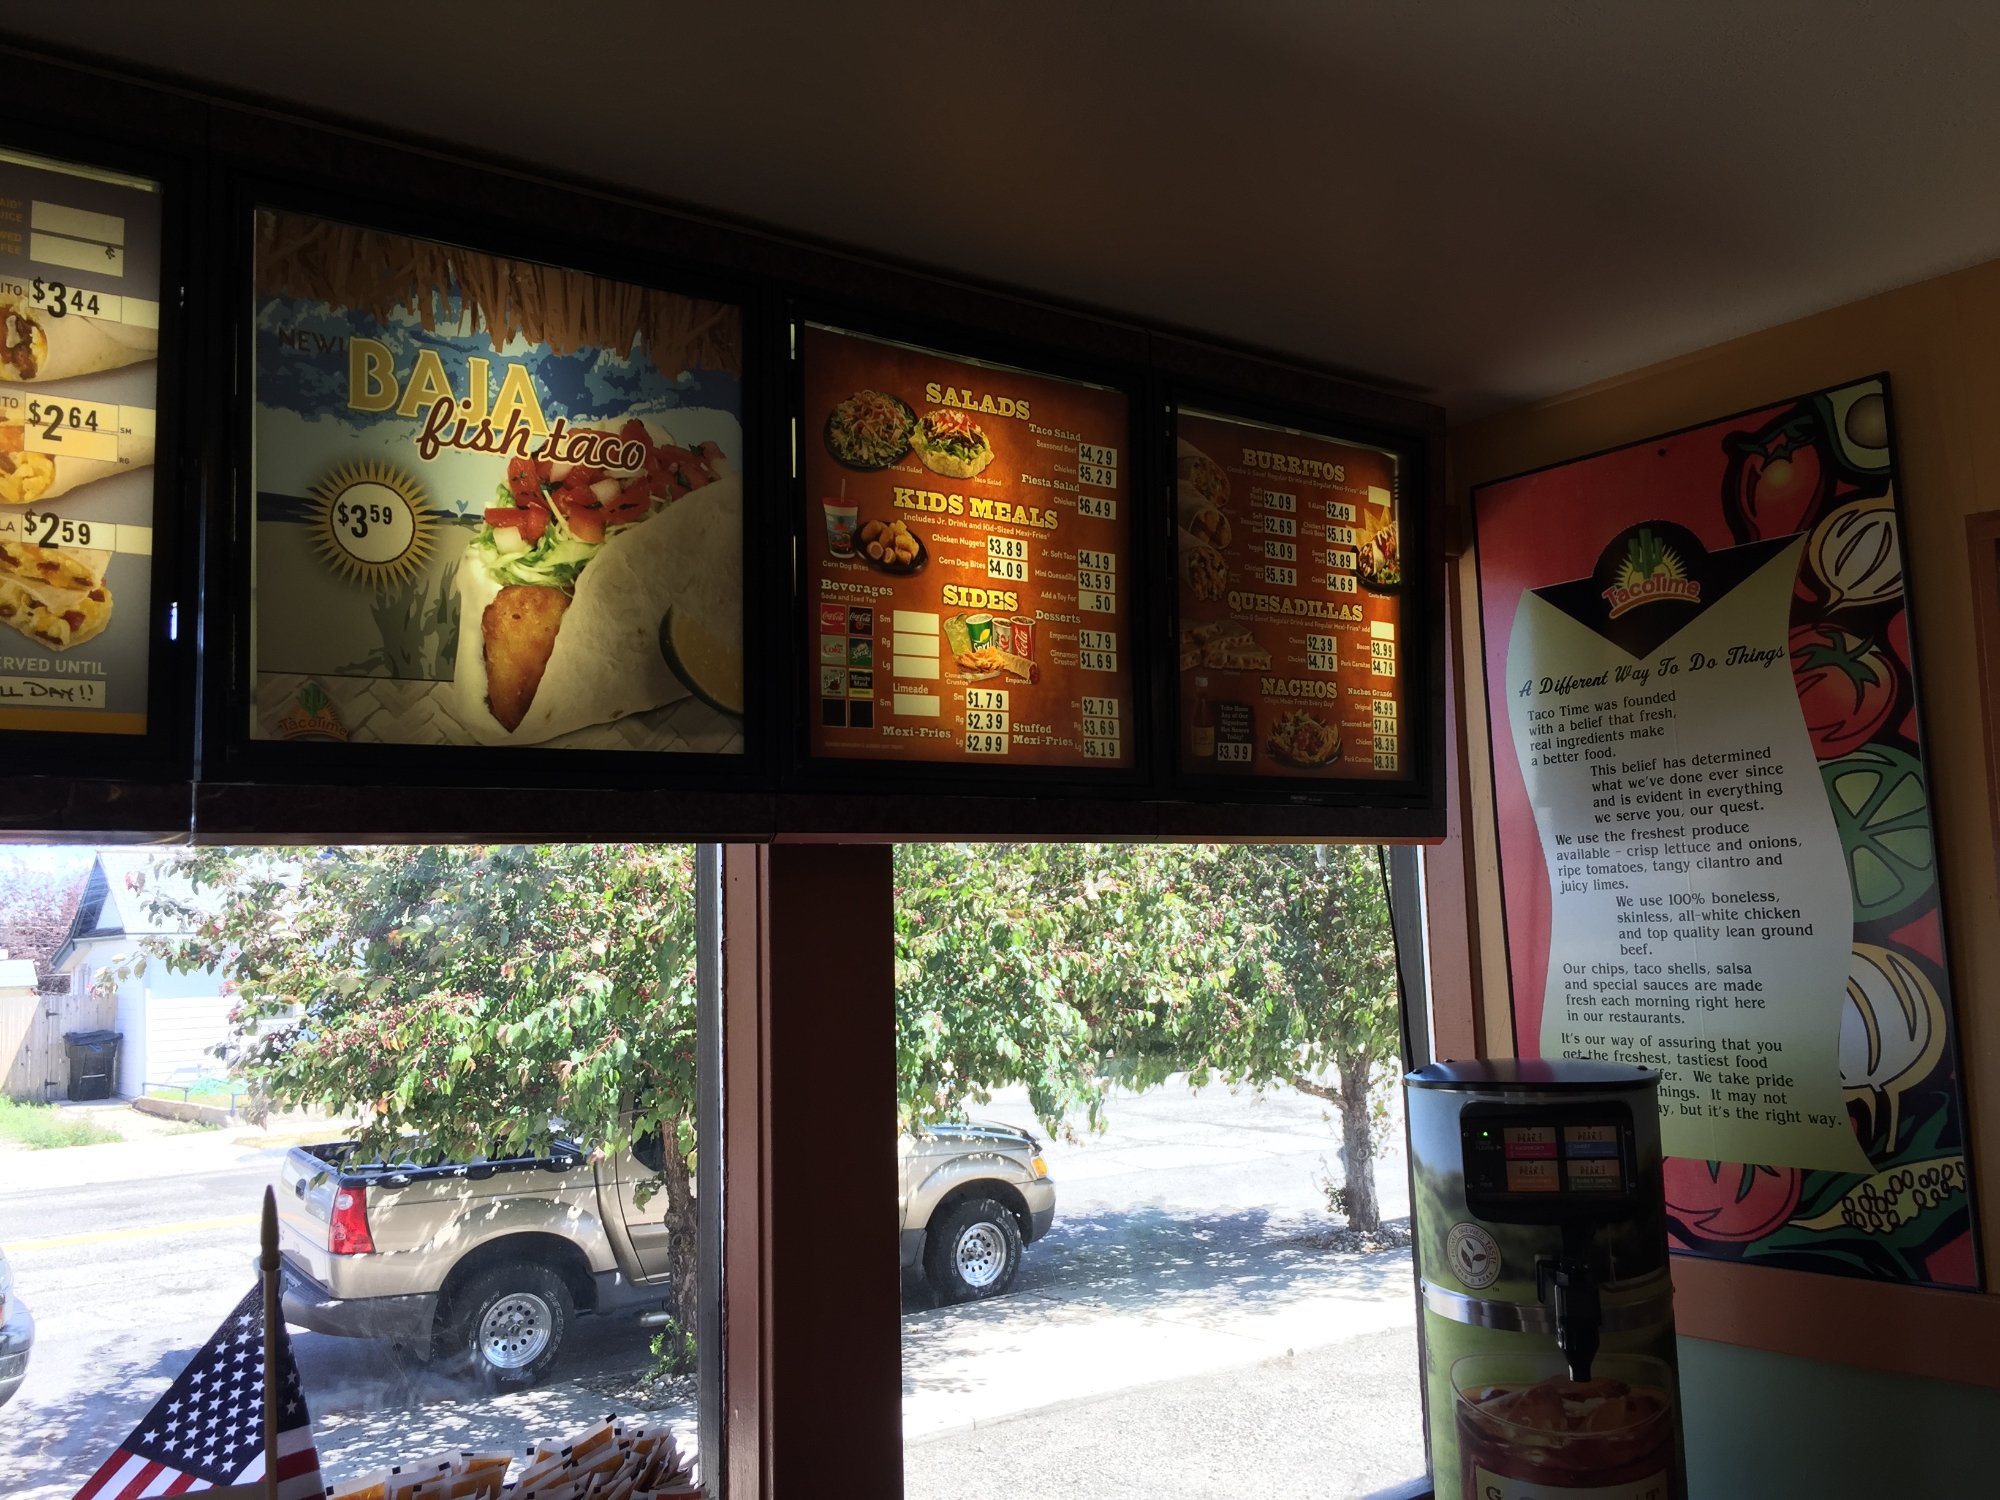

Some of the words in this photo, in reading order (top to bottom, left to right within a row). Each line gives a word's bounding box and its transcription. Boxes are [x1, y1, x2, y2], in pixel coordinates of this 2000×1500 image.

[278, 329, 347, 353] NEW!
[347, 336, 550, 438] BAJA
[925, 382, 1031, 420] SALADS
[416, 395, 530, 461] fish
[540, 418, 647, 472] taco
[1029, 423, 1053, 436] Taco
[1054, 428, 1081, 441] Salad
[1080, 445, 1112, 465] $4.29
[1054, 465, 1076, 474] Chicken
[1242, 448, 1345, 482] BURRITOS
[1021, 475, 1051, 487] Fiesta
[1053, 480, 1080, 492] Salad
[1079, 466, 1112, 485] $5.29
[894, 487, 964, 515] KIDS
[969, 497, 1058, 530] MEALS
[1054, 496, 1076, 506] Chicken
[1080, 498, 1110, 517] $6.49
[1264, 492, 1291, 509] $2.09
[1328, 502, 1350, 520] $2.49
[903, 513, 935, 524] Includes
[937, 517, 947, 526] Jr.
[948, 518, 968, 528] Drink
[969, 521, 982, 529] and
[983, 523, 1014, 534] Kid-Sized
[1266, 518, 1292, 534] $2.69
[932, 534, 958, 544] Chicken
[959, 537, 985, 548] Nuggets
[1328, 527, 1352, 543] $5.19
[989, 538, 1022, 557] $3.89
[1051, 550, 1063, 559] Soft
[1267, 542, 1292, 559] $3.09
[840, 562, 852, 571] Dog
[939, 557, 955, 565] Corn
[956, 559, 969, 569] Dog
[970, 561, 985, 569] Bites
[1079, 551, 1109, 570] $4.19
[1328, 552, 1351, 568] $3.89
[990, 560, 1022, 579] $4.09
[1035, 569, 1047, 577] Mini
[1048, 571, 1076, 581] Quesadilla
[1267, 568, 1292, 584] $5.59
[821, 579, 893, 597] Beverages
[1080, 572, 1110, 589] $3.59
[1328, 576, 1353, 592] $4.69
[943, 584, 1018, 612] SIDES
[1602, 573, 1700, 606] TacoTime
[1090, 596, 1110, 610] .50
[1227, 591, 1363, 622] QUESADILLAS
[880, 615, 891, 623] Sm
[1036, 610, 1080, 624] Desserts
[882, 638, 890, 647] Rg
[1050, 631, 1077, 641] Empanada
[1081, 632, 1110, 648] $1.79
[1308, 636, 1332, 651] $2.39
[1372, 642, 1392, 657] $3.99
[56, 660, 107, 675] UNTIL
[883, 661, 890, 670] Lg
[1081, 652, 1112, 668] $1.69
[1308, 656, 1333, 670] $4.79
[1373, 660, 1392, 675] $4.79
[1519, 680, 1533, 697] A
[1538, 670, 1609, 696] Different
[1614, 665, 1651, 687] Way
[1657, 656, 1681, 677] To
[1688, 652, 1718, 672] Do
[1725, 644, 1785, 669] Things
[893, 683, 929, 695] Limeade
[1261, 678, 1338, 699] NACHOS
[1347, 687, 1371, 697] Nachos
[968, 690, 1002, 709] $1.79
[1083, 698, 1113, 715] $2.79
[1527, 709, 1555, 721] Taco
[1559, 704, 1590, 717] Time
[1594, 700, 1618, 712] was
[1623, 689, 1677, 708] founded
[1374, 701, 1393, 716] $6.99
[968, 713, 1002, 730] $2.39
[1013, 723, 1051, 734] Stuffed
[1084, 720, 1114, 735] $3.69
[1374, 720, 1394, 734] $7.84
[1529, 723, 1554, 736] with
[1558, 723, 1565, 733] a
[1570, 715, 1603, 731] belief
[1608, 712, 1635, 726] that
[1639, 707, 1676, 722] fresh,
[883, 725, 952, 739] Mexi-Fries
[1013, 734, 1074, 747] Mexi-Fries
[1530, 738, 1552, 751] real
[1556, 730, 1625, 750] ingredients
[1629, 725, 1665, 739] make
[967, 735, 1002, 752] $2.99
[1085, 740, 1115, 757] $5.19
[1219, 744, 1248, 759] $3.99
[1374, 739, 1394, 751] $8.39
[1374, 756, 1394, 769] $8.39
[1531, 758, 1538, 766] a
[1543, 752, 1580, 765] better
[1584, 746, 1616, 761] food.
[1589, 763, 1617, 777] This
[1621, 758, 1657, 774] belief
[1663, 757, 1686, 770] has
[1691, 746, 1771, 766] determined
[1591, 778, 1623, 792] what
[1627, 775, 1665, 789] we've
[1669, 772, 1703, 785] done
[1708, 769, 1739, 781] ever
[1745, 764, 1784, 778] since
[1594, 813, 1611, 824] we
[1616, 810, 1651, 822] serve
[1655, 808, 1685, 822] you,
[1690, 805, 1714, 816] our
[1719, 799, 1764, 817] quest.
[1616, 896, 1634, 907] We
[1639, 897, 1663, 906] use
[1669, 892, 1705, 905] 100%
[1711, 890, 1780, 904] boneless,
[1617, 911, 1673, 923] skinless,
[1678, 908, 1739, 922] all-white
[1744, 907, 1801, 920] chicken
[1619, 927, 1642, 939] and
[1647, 927, 1668, 941] top
[1673, 925, 1720, 941] quality
[1726, 925, 1755, 937] lean
[1761, 923, 1814, 940] ground
[1620, 943, 1652, 955] beef.
